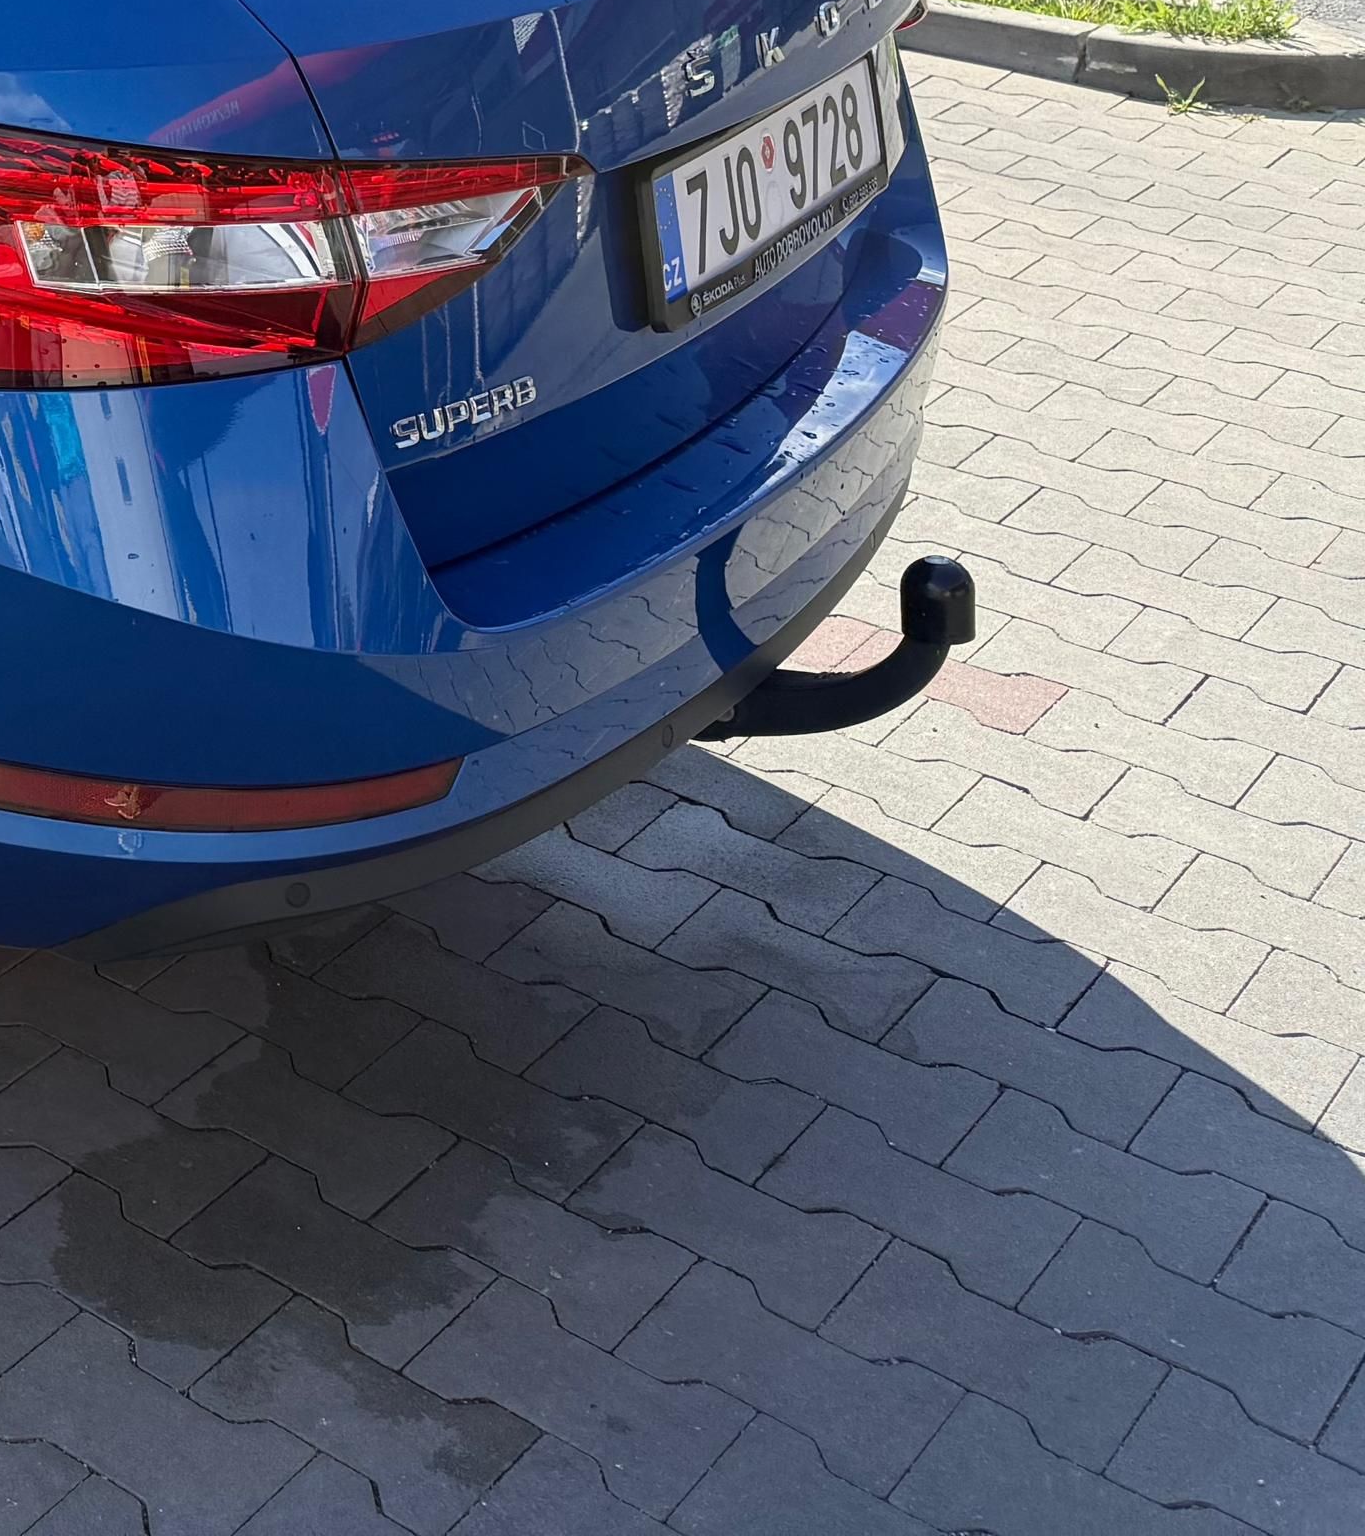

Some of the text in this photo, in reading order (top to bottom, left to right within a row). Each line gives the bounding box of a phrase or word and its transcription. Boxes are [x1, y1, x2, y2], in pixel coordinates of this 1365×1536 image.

[783, 83, 863, 210] 9728
[662, 256, 683, 292] CZ
[702, 280, 735, 305] ŠKODA
[754, 246, 776, 281] AUTO
[777, 205, 834, 263] DOBROVOLNÝ
[389, 375, 537, 449] SUPERB
